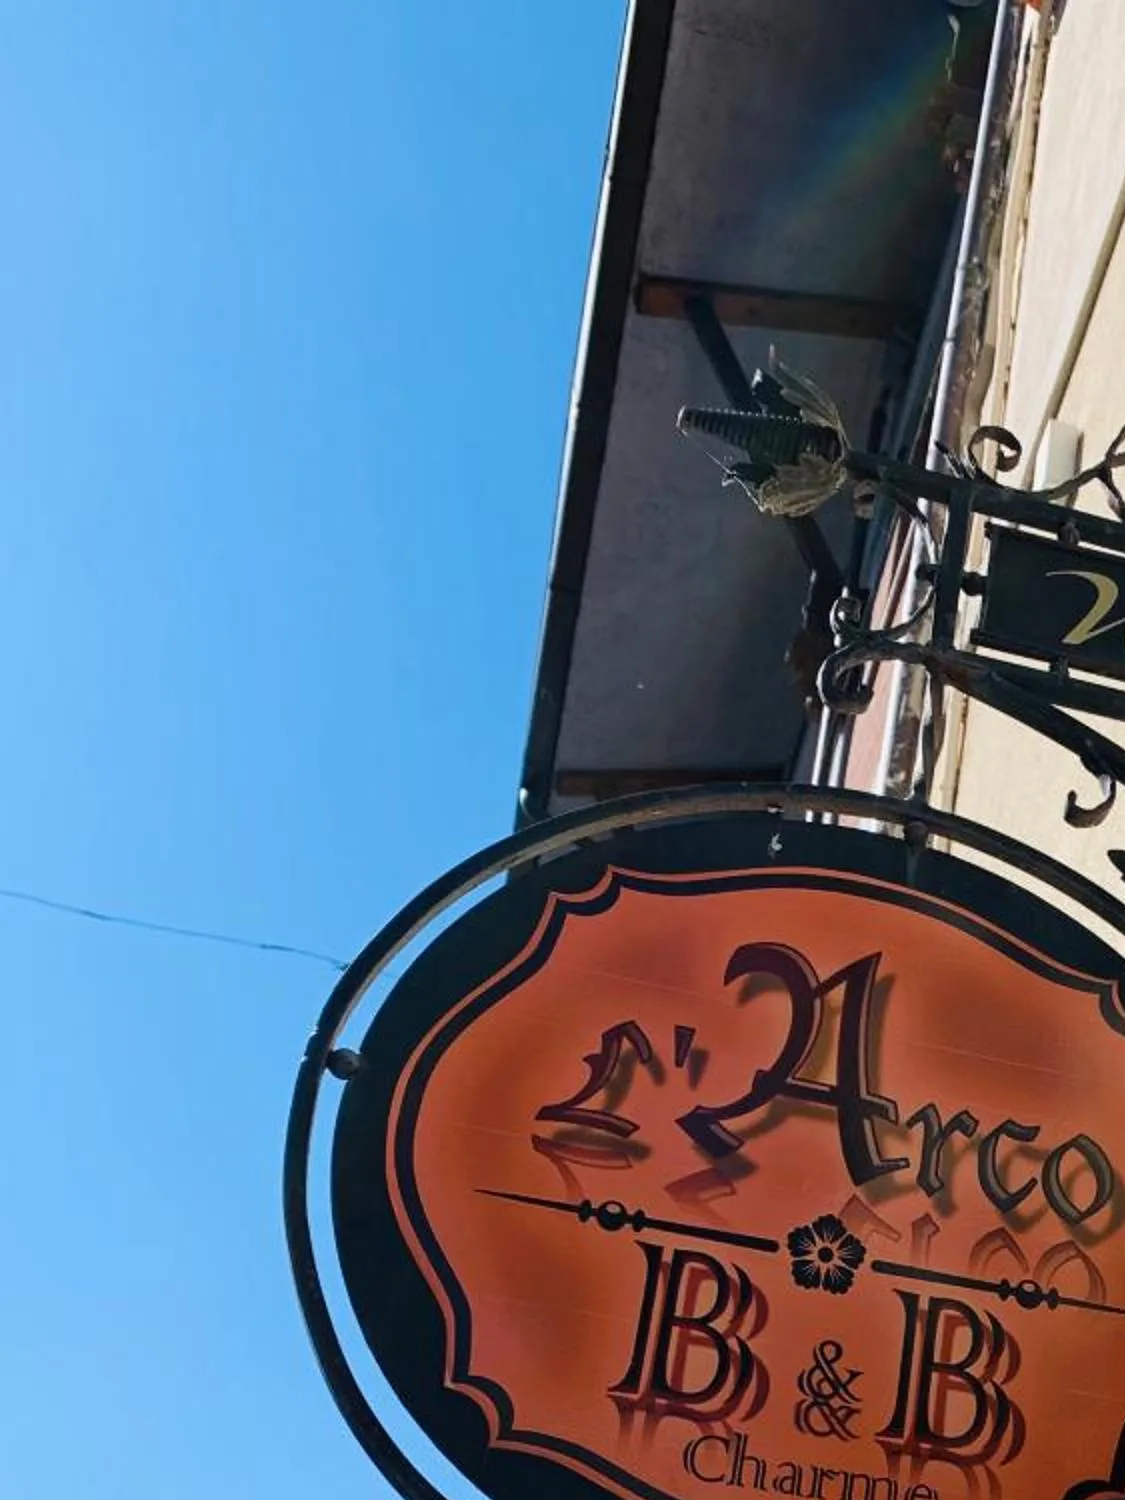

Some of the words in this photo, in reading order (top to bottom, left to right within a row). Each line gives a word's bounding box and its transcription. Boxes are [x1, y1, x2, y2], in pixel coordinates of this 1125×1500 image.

[608, 1239, 754, 1406] B
[798, 1338, 865, 1404] &
[876, 1288, 1006, 1449] B
